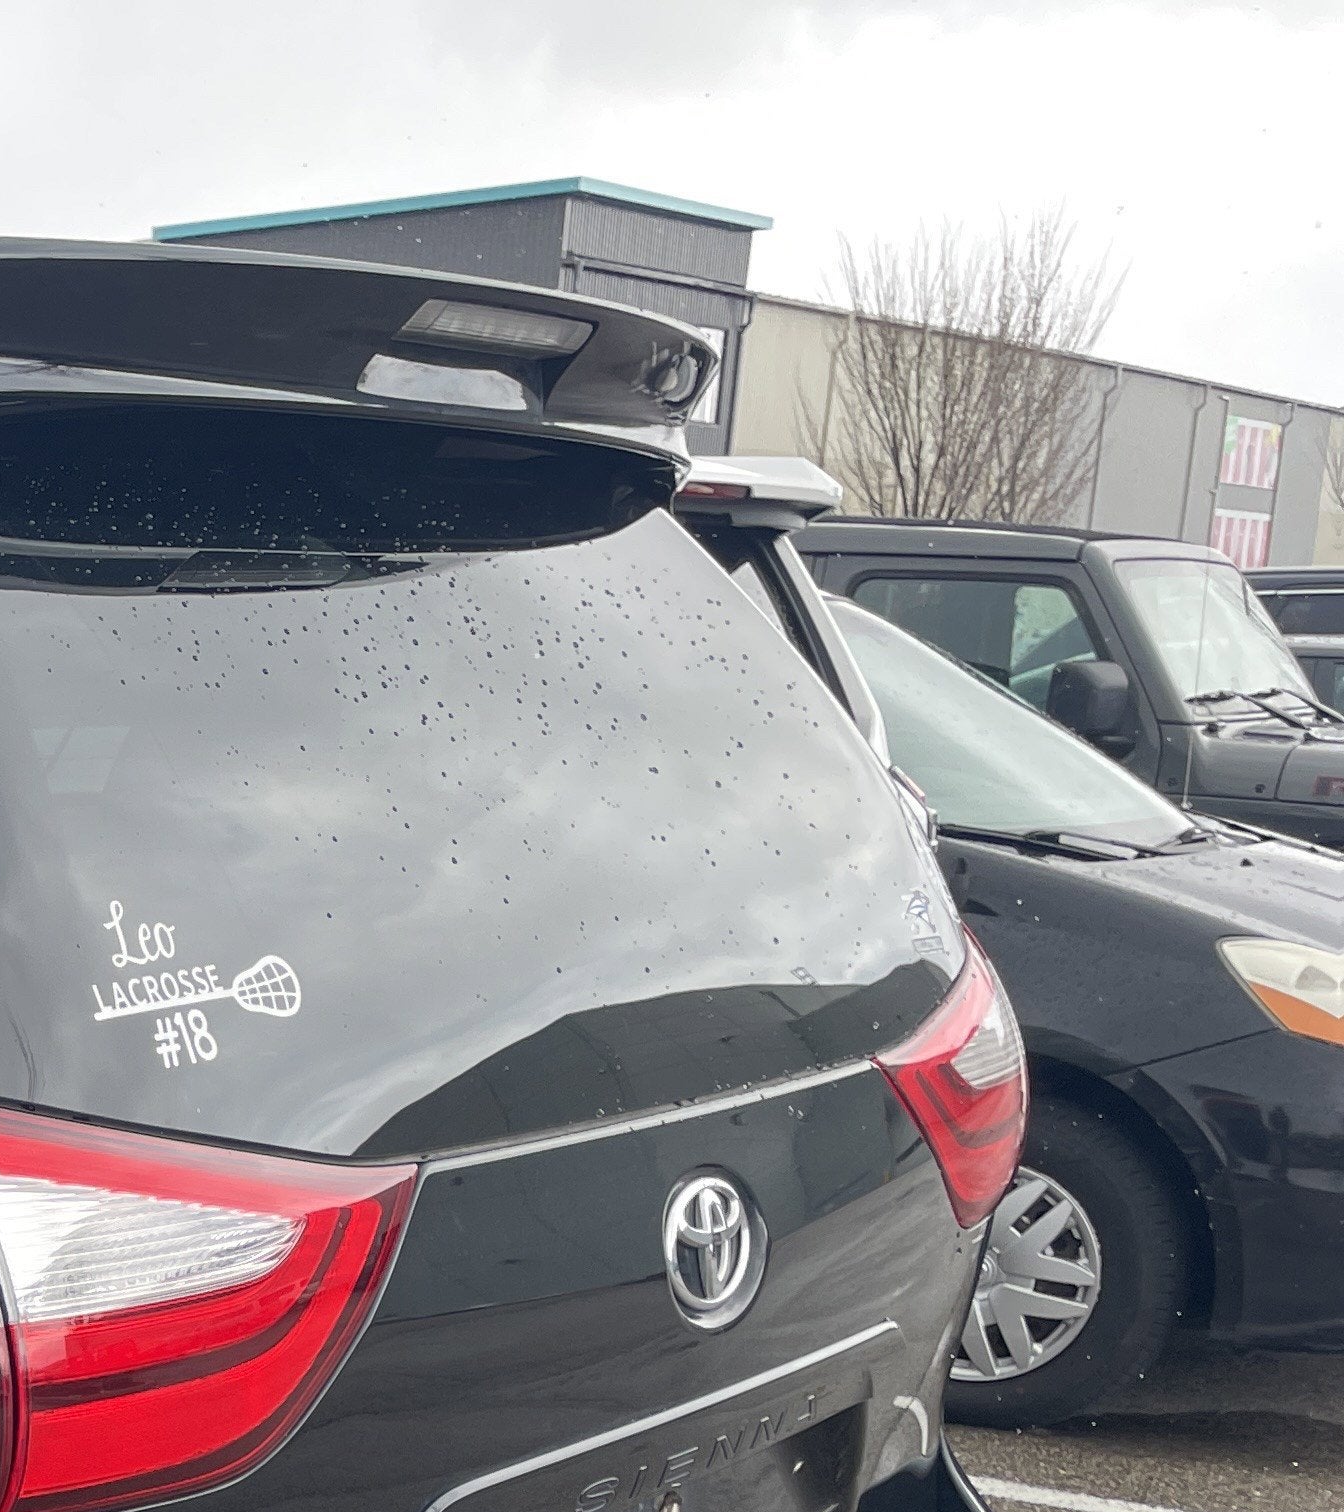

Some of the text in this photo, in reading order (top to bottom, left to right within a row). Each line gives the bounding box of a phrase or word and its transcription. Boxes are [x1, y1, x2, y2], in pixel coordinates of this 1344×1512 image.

[102, 899, 176, 969] Leo
[92, 963, 224, 1014] LACROSSE
[153, 1007, 219, 1070] #18
